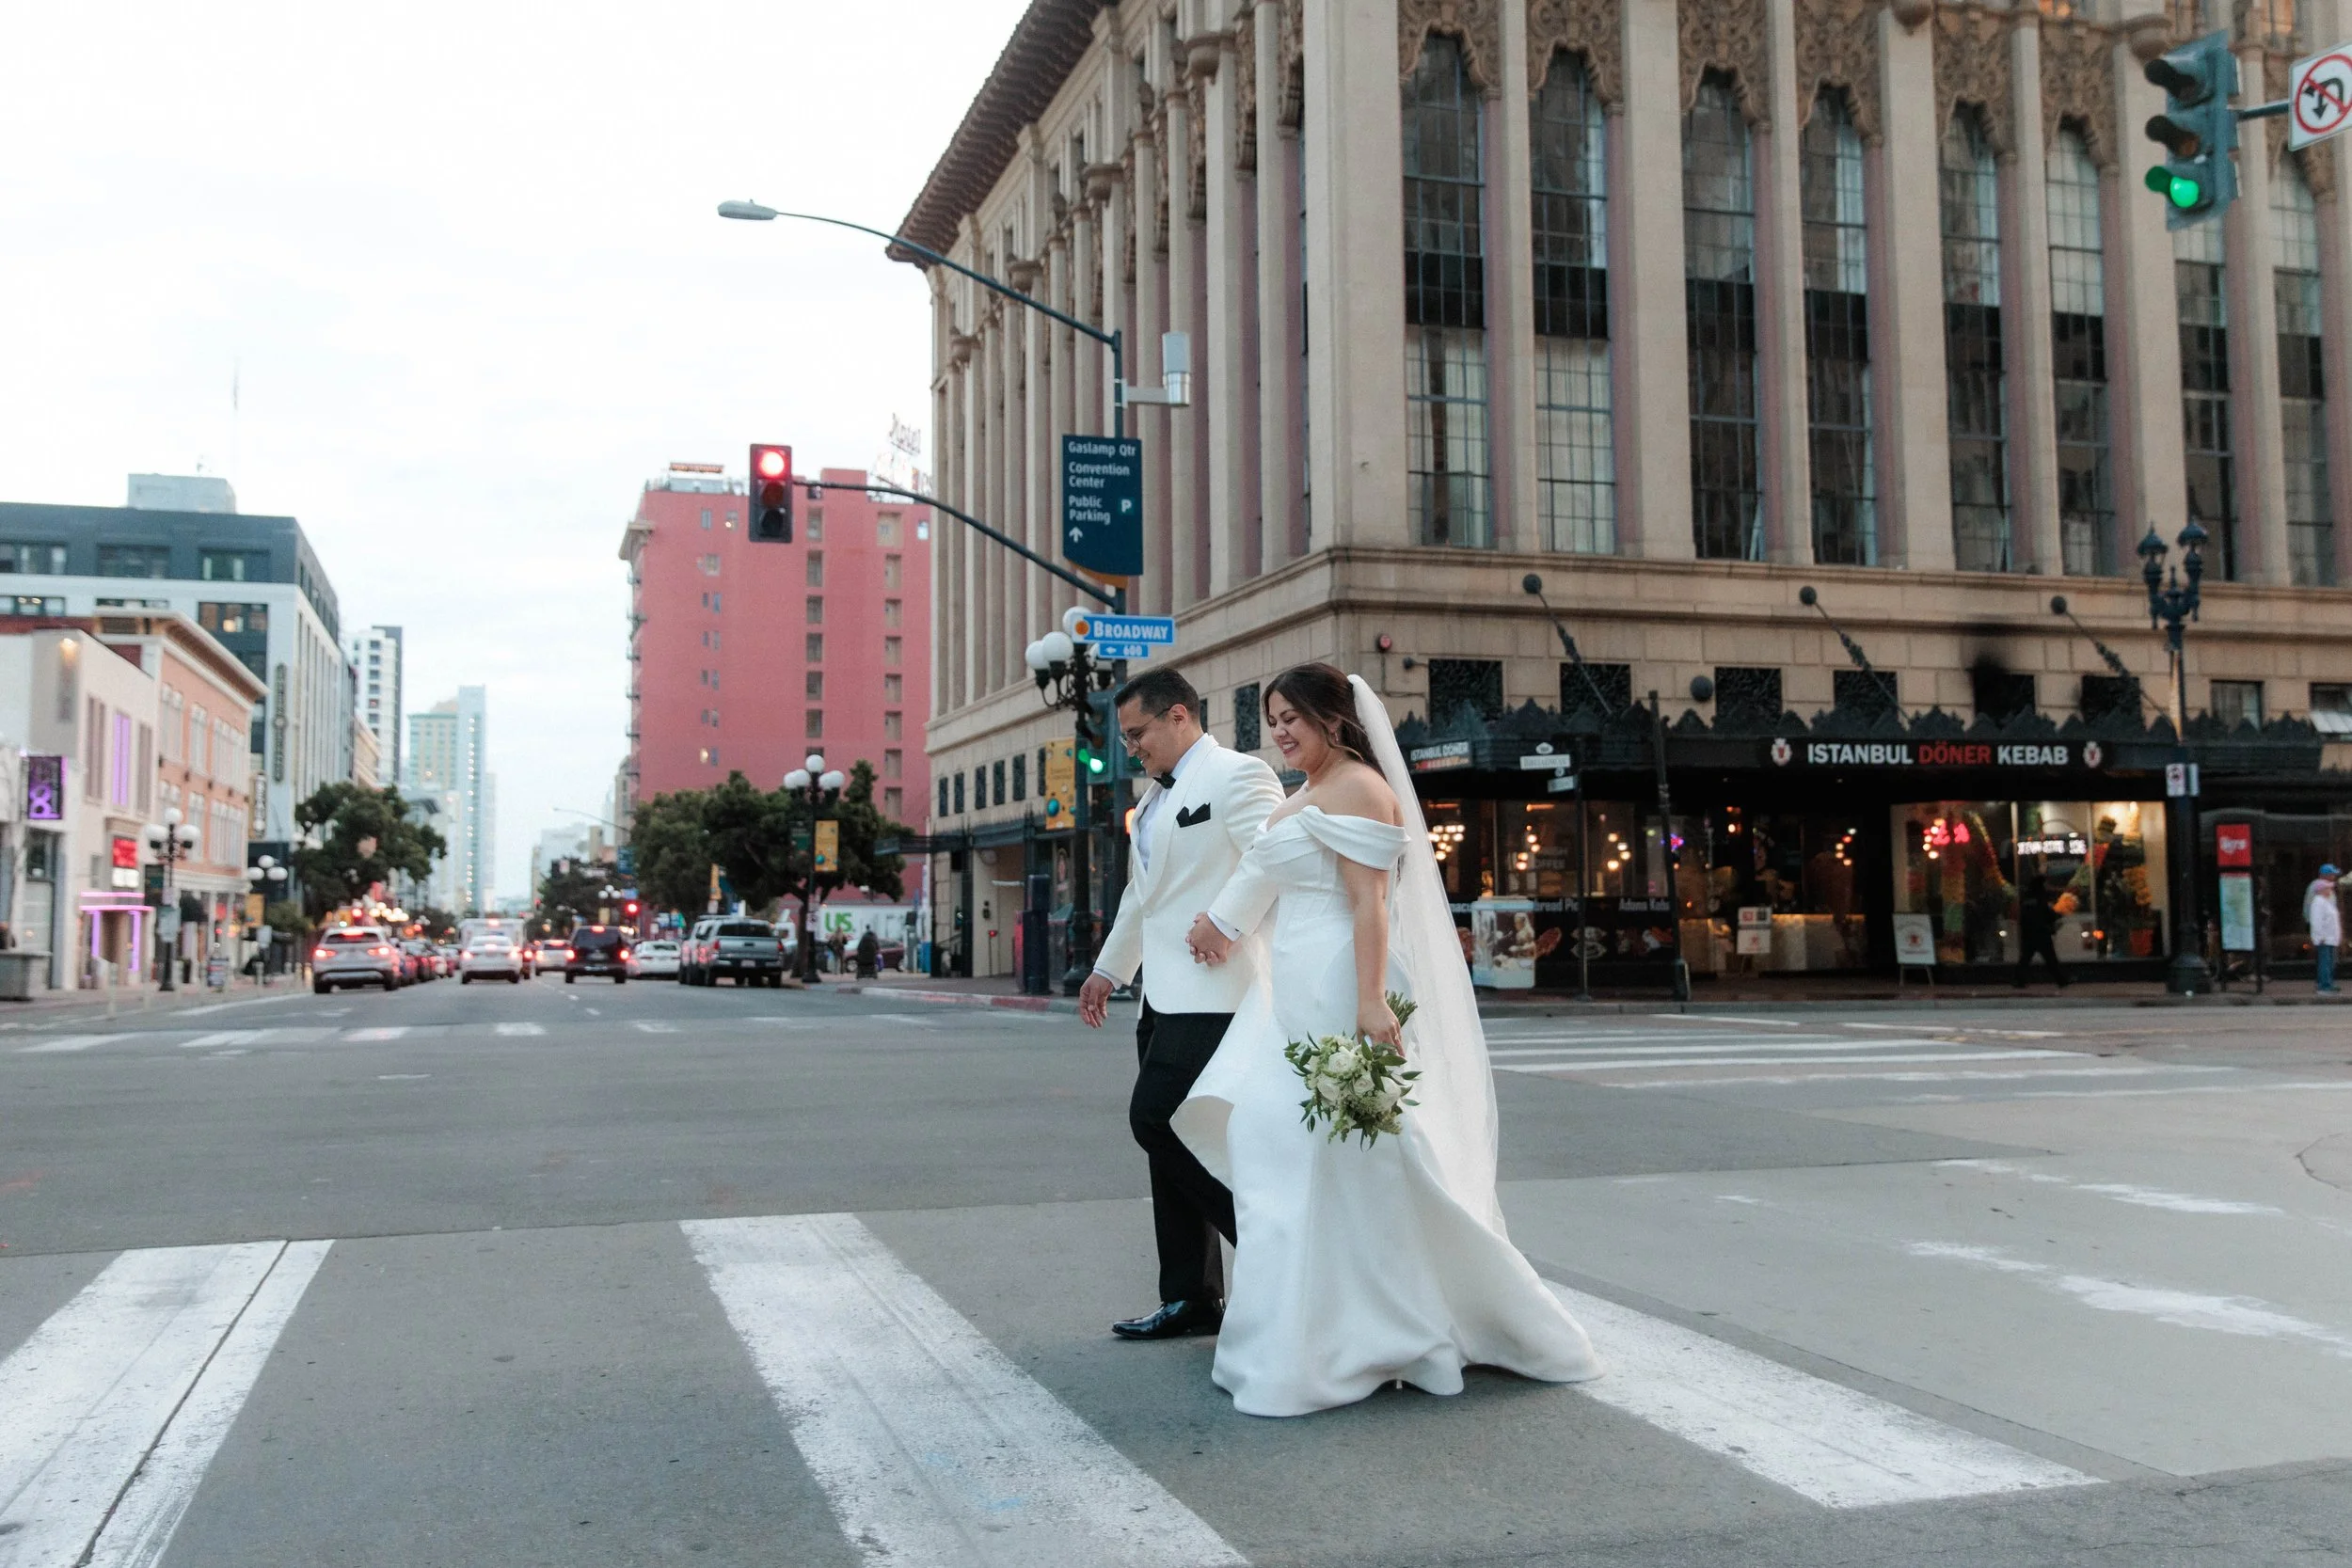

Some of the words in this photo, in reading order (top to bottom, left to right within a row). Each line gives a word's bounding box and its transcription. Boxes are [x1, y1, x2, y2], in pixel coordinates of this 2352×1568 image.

[1068, 441, 1116, 458] Gaslamp
[1119, 443, 1136, 457] Qtr
[1068, 461, 1130, 476] Convention
[1068, 475, 1105, 488] Center
[1068, 494, 1103, 508] Public
[1120, 499, 1133, 513] P
[1069, 509, 1111, 526] Parking
[1093, 620, 1168, 640] BROADWAY
[1122, 644, 1143, 657] 600
[1807, 742, 1914, 765] ISTANBUL
[1918, 740, 1992, 766] DÖNER
[1997, 745, 2069, 766] KEBAB
